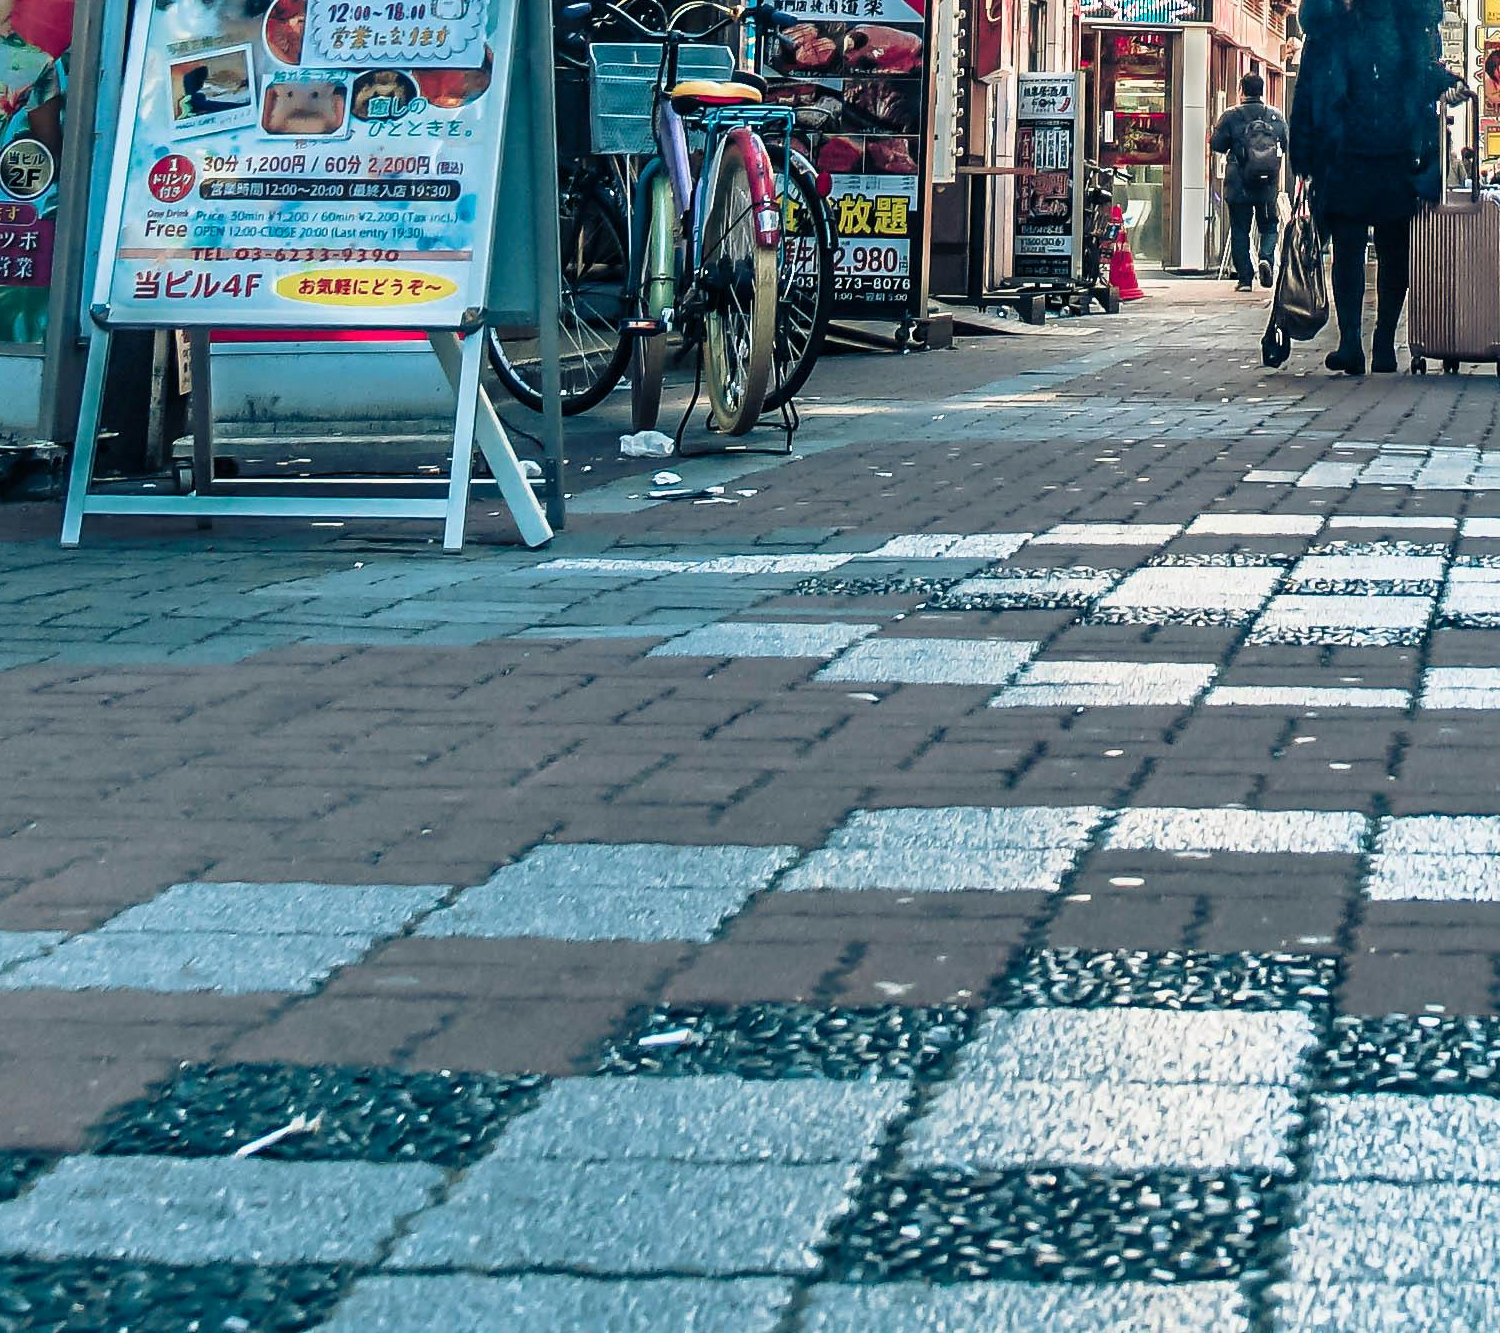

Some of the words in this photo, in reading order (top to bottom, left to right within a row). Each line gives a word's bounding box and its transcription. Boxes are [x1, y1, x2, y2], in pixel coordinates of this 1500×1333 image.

[8, 151, 45, 166] 当ビル
[168, 158, 178, 172] 1
[202, 155, 237, 173] 30分
[245, 155, 306, 175] 1,200円
[325, 155, 362, 173] 60分
[367, 155, 430, 176] 2,200円
[8, 167, 42, 189] 2F
[152, 173, 191, 185] ドリンク
[144, 220, 188, 238] Free
[834, 247, 898, 276] 2,980
[133, 270, 263, 299] 当ビル4F
